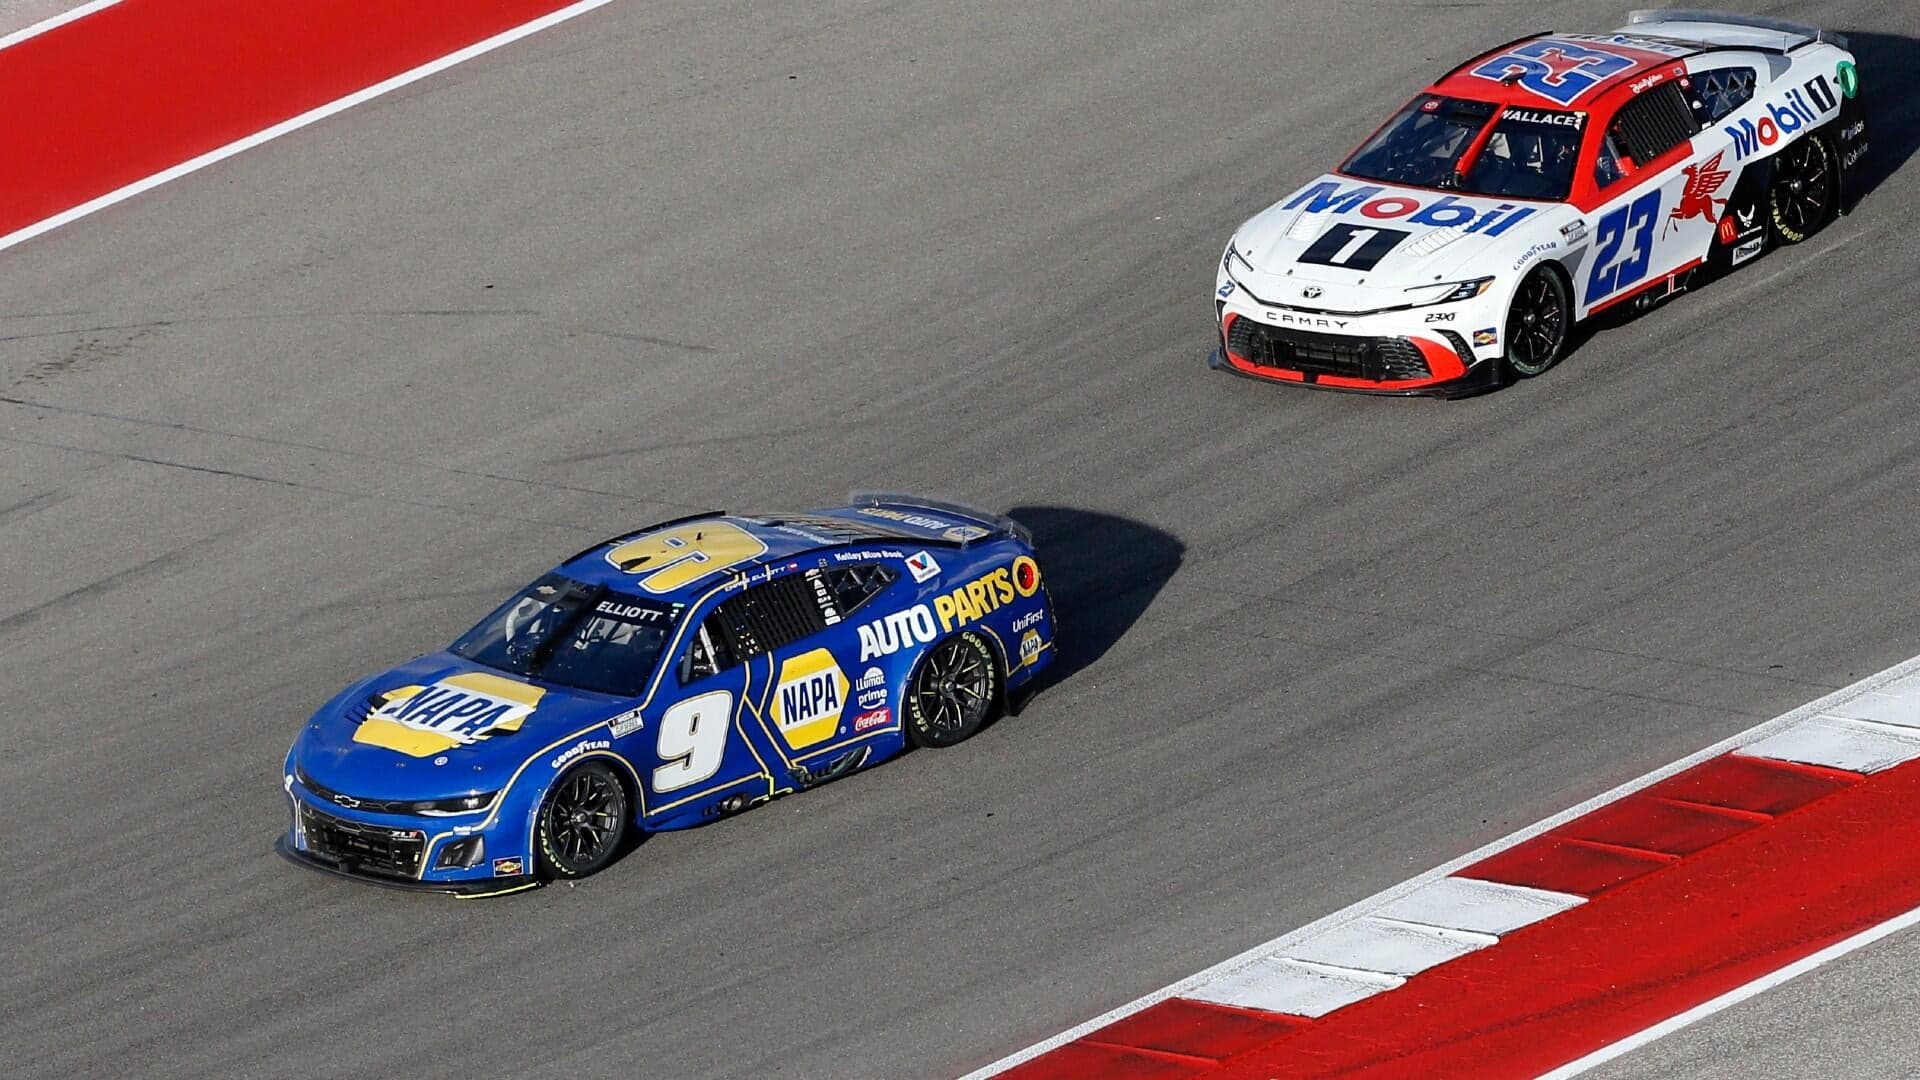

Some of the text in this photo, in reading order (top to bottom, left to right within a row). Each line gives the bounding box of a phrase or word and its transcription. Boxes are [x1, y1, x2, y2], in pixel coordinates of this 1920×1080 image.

[1470, 39, 1638, 106] 23
[1502, 109, 1575, 126] WALLACE
[1724, 88, 1817, 161] Mobil
[1810, 79, 1832, 109] 1
[1281, 182, 1537, 237] Mobil
[1329, 229, 1380, 264] 1
[1513, 242, 1557, 271] GOODYEAR
[1583, 188, 1661, 307] 23
[1266, 311, 1349, 328] CAMRY
[605, 521, 769, 594] 9
[834, 549, 903, 561] Kelley Blue Book
[596, 600, 664, 622] ELLIOTT
[857, 568, 1014, 662] AUTO PARTS
[1012, 608, 1043, 632] UniFirst
[1022, 637, 1040, 657] NAPA
[381, 685, 514, 737] NAPA
[783, 673, 839, 725] NAPA
[858, 687, 888, 708] prime
[910, 694, 929, 733] EAGLE
[551, 740, 610, 769] GOODYEAR
[652, 690, 733, 793] 9
